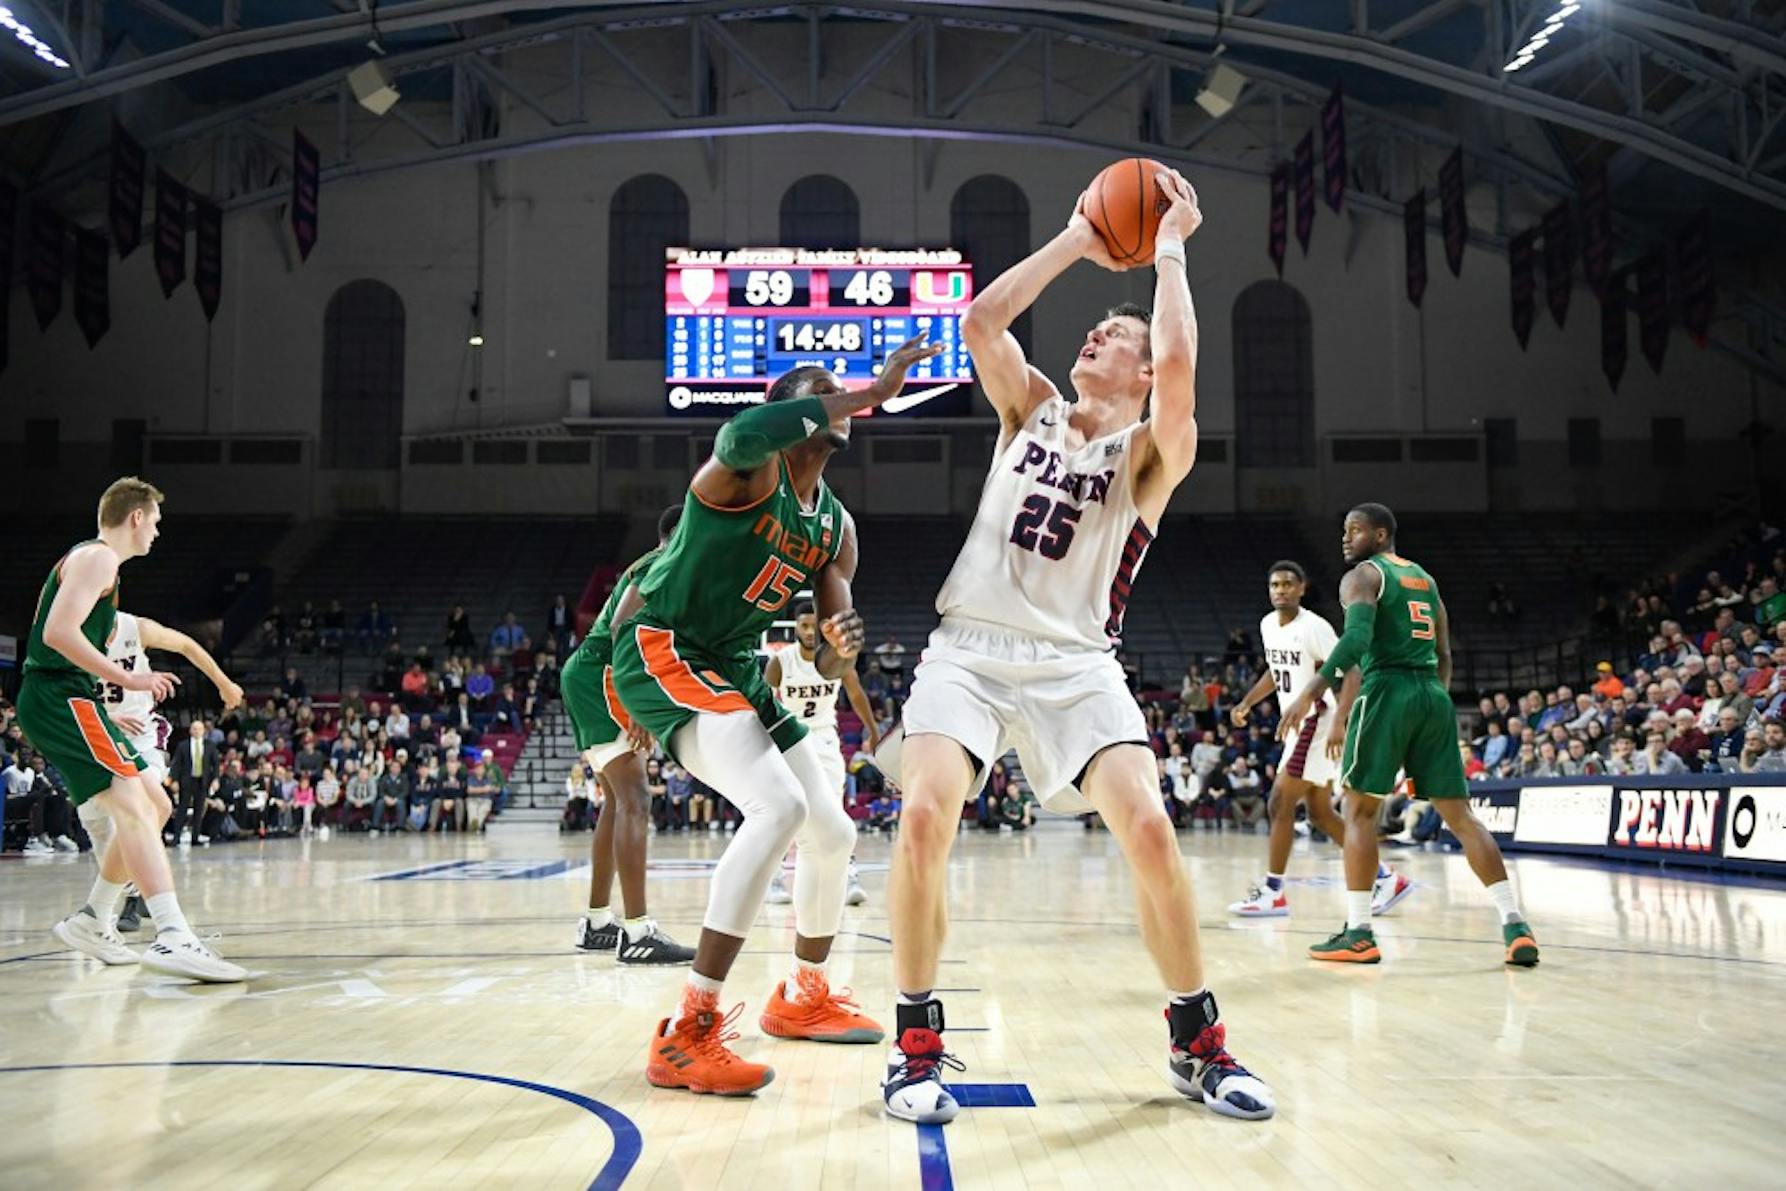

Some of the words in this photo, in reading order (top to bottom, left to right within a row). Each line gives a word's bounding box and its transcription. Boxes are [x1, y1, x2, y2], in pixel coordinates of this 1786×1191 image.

[745, 271, 793, 306] 59
[844, 271, 894, 306] 46
[778, 323, 861, 351] 14:48
[833, 358, 847, 374] 2
[1013, 440, 1115, 505] PENN
[1010, 494, 1083, 561] 25
[742, 554, 806, 612] 15
[1407, 601, 1435, 641] 5
[786, 683, 836, 699] PENN
[803, 701, 817, 718] 2
[1614, 789, 1720, 851] PENN
